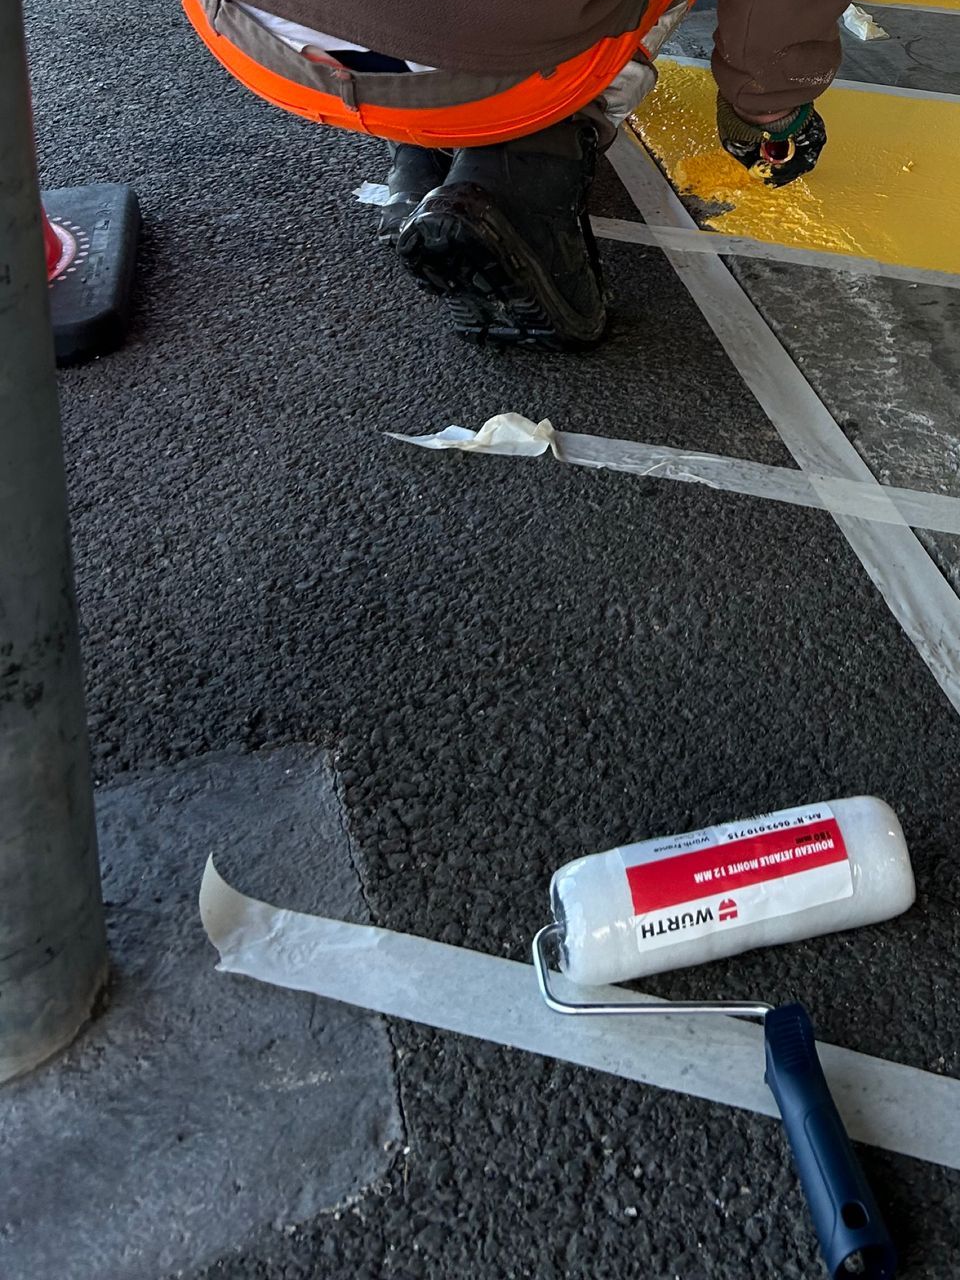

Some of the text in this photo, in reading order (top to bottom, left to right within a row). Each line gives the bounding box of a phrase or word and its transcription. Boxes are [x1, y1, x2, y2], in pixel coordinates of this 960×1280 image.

[694, 839, 834, 883] ROULEAU JETABLE MONTE 12 MM
[641, 907, 714, 939] WÜRTH
